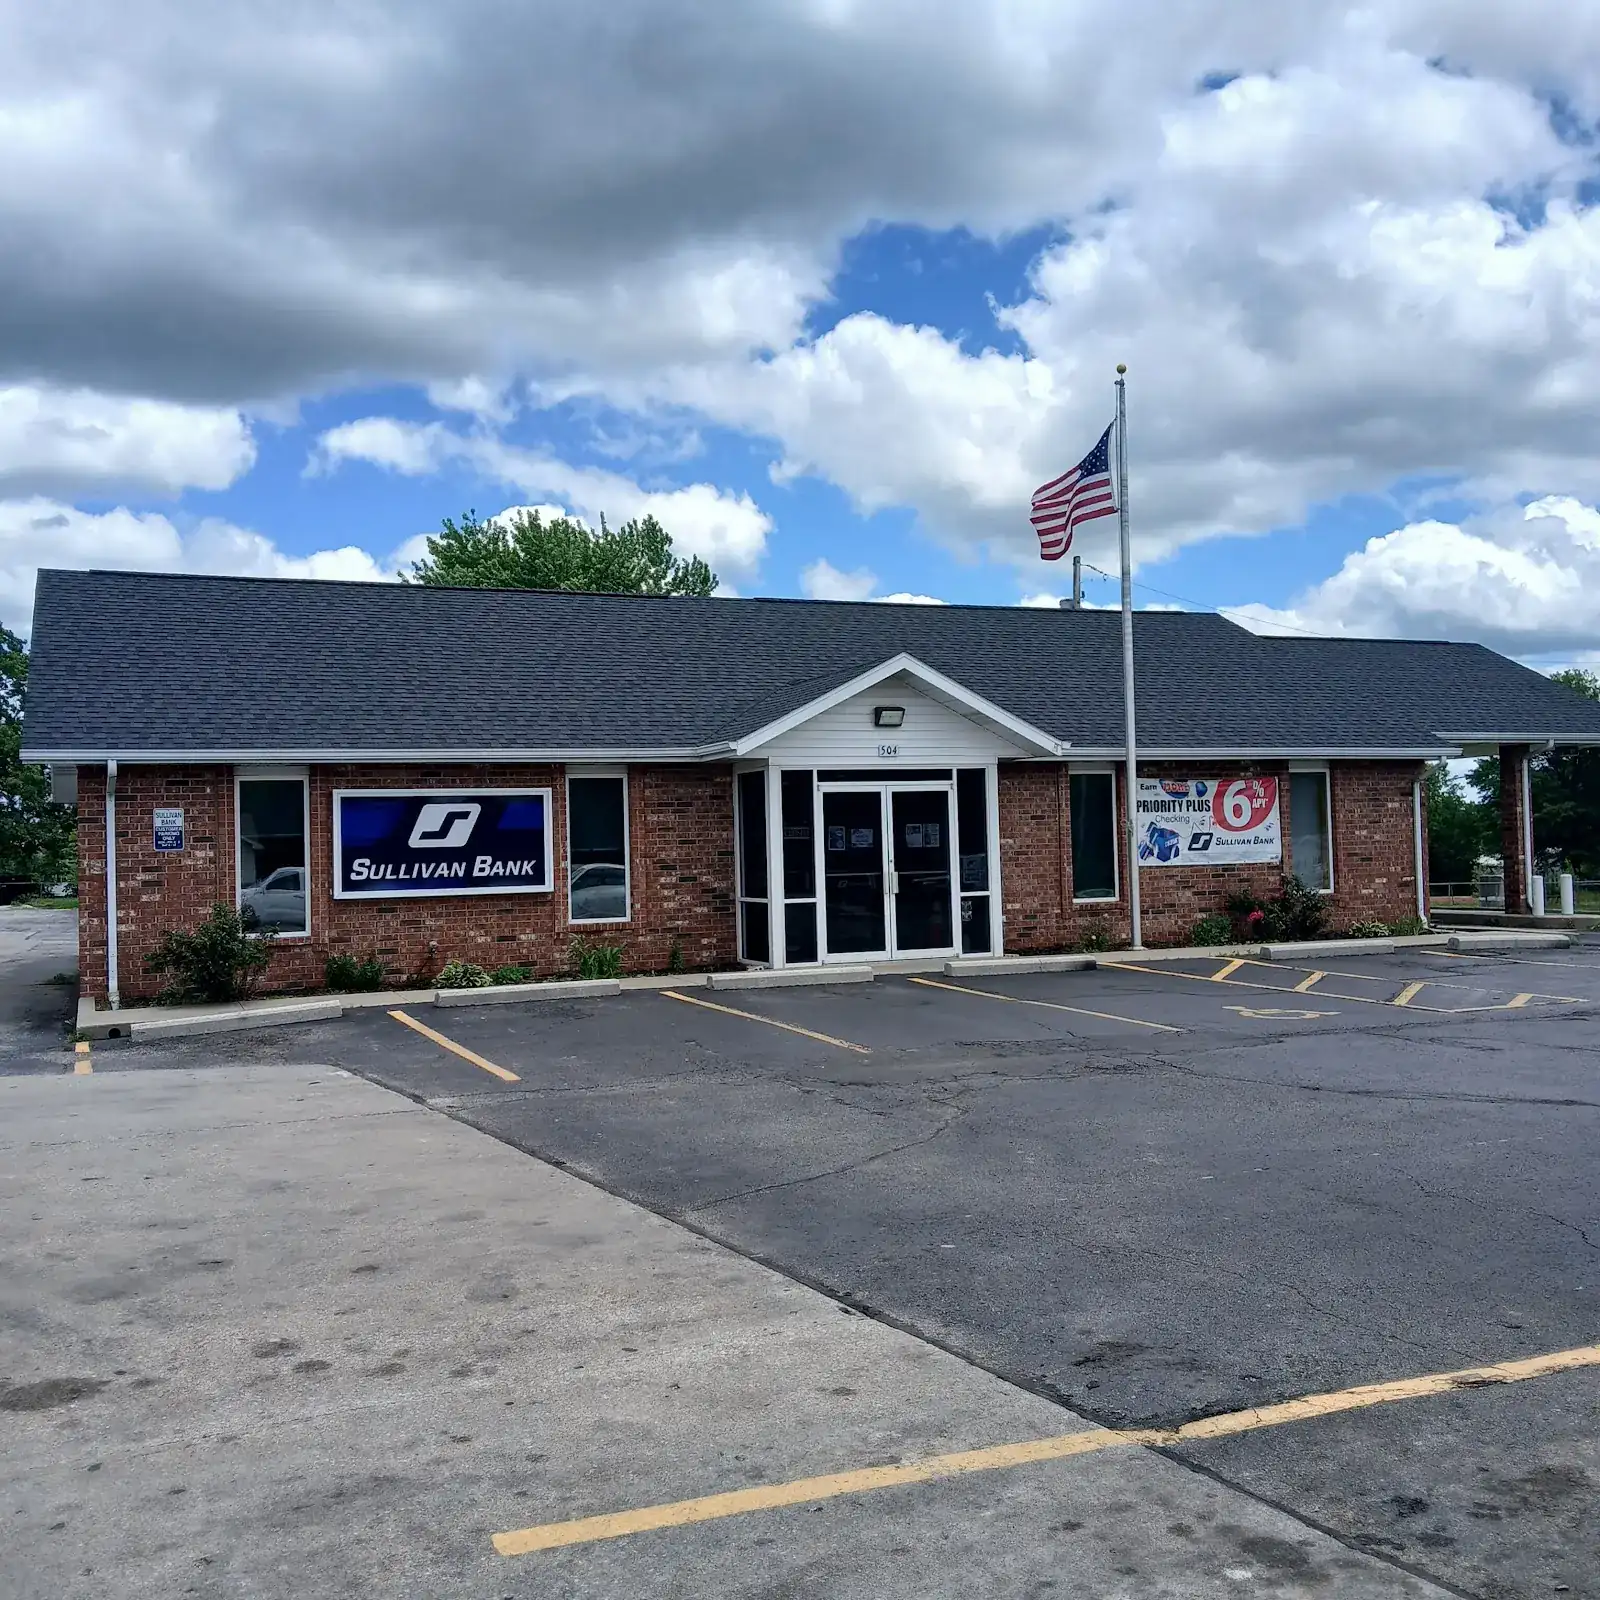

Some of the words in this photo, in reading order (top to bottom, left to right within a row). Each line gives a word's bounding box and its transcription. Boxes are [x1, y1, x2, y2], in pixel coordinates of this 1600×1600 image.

[880, 745, 897, 756] 504
[1140, 783, 1158, 791] Earn
[1136, 800, 1184, 813] PRIORITY
[1186, 799, 1211, 812] PLUS
[1223, 780, 1252, 828] 6
[1155, 814, 1190, 824] Checking
[1215, 837, 1252, 846] SULLIVAN
[1253, 836, 1275, 845] BANK
[350, 858, 467, 881] SULLIVAN
[472, 855, 537, 877] BANK
